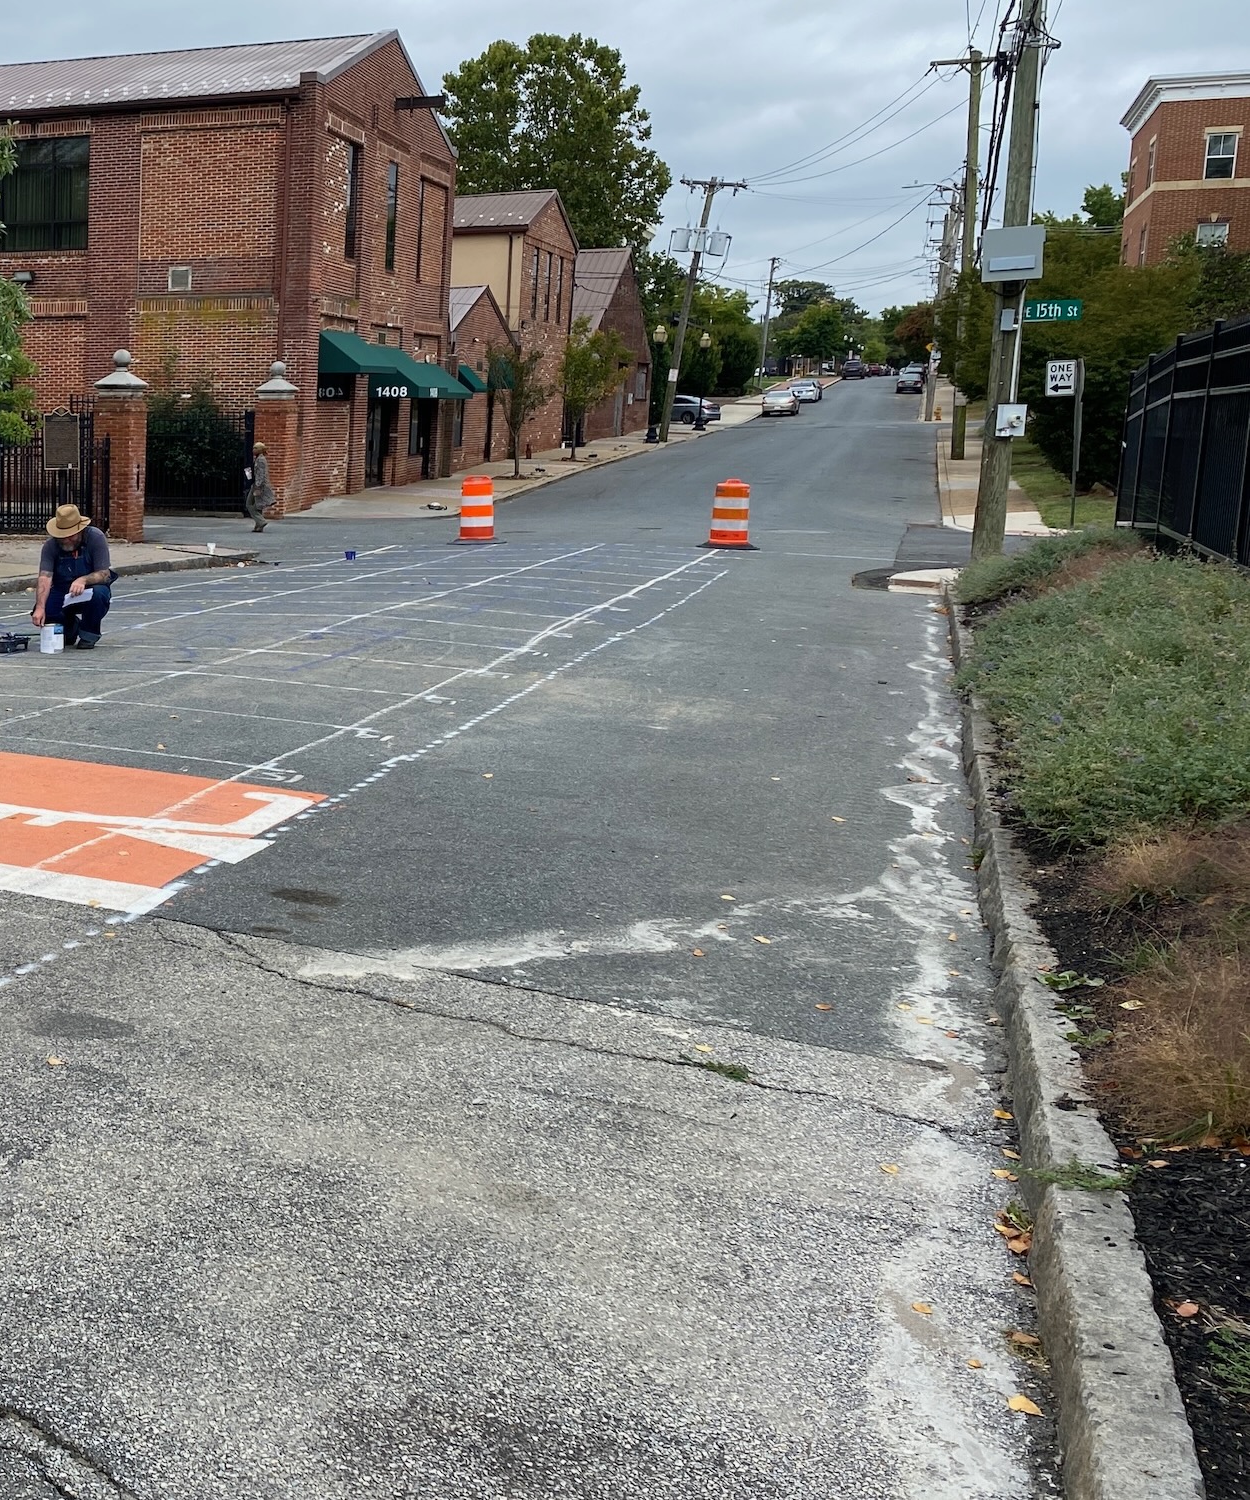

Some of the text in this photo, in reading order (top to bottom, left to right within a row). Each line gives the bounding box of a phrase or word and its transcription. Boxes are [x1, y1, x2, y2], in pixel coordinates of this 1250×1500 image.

[1026, 303, 1079, 318] E 15th St
[1050, 364, 1073, 373] ONE
[1050, 373, 1073, 382] WAY
[376, 386, 408, 398] 1408
